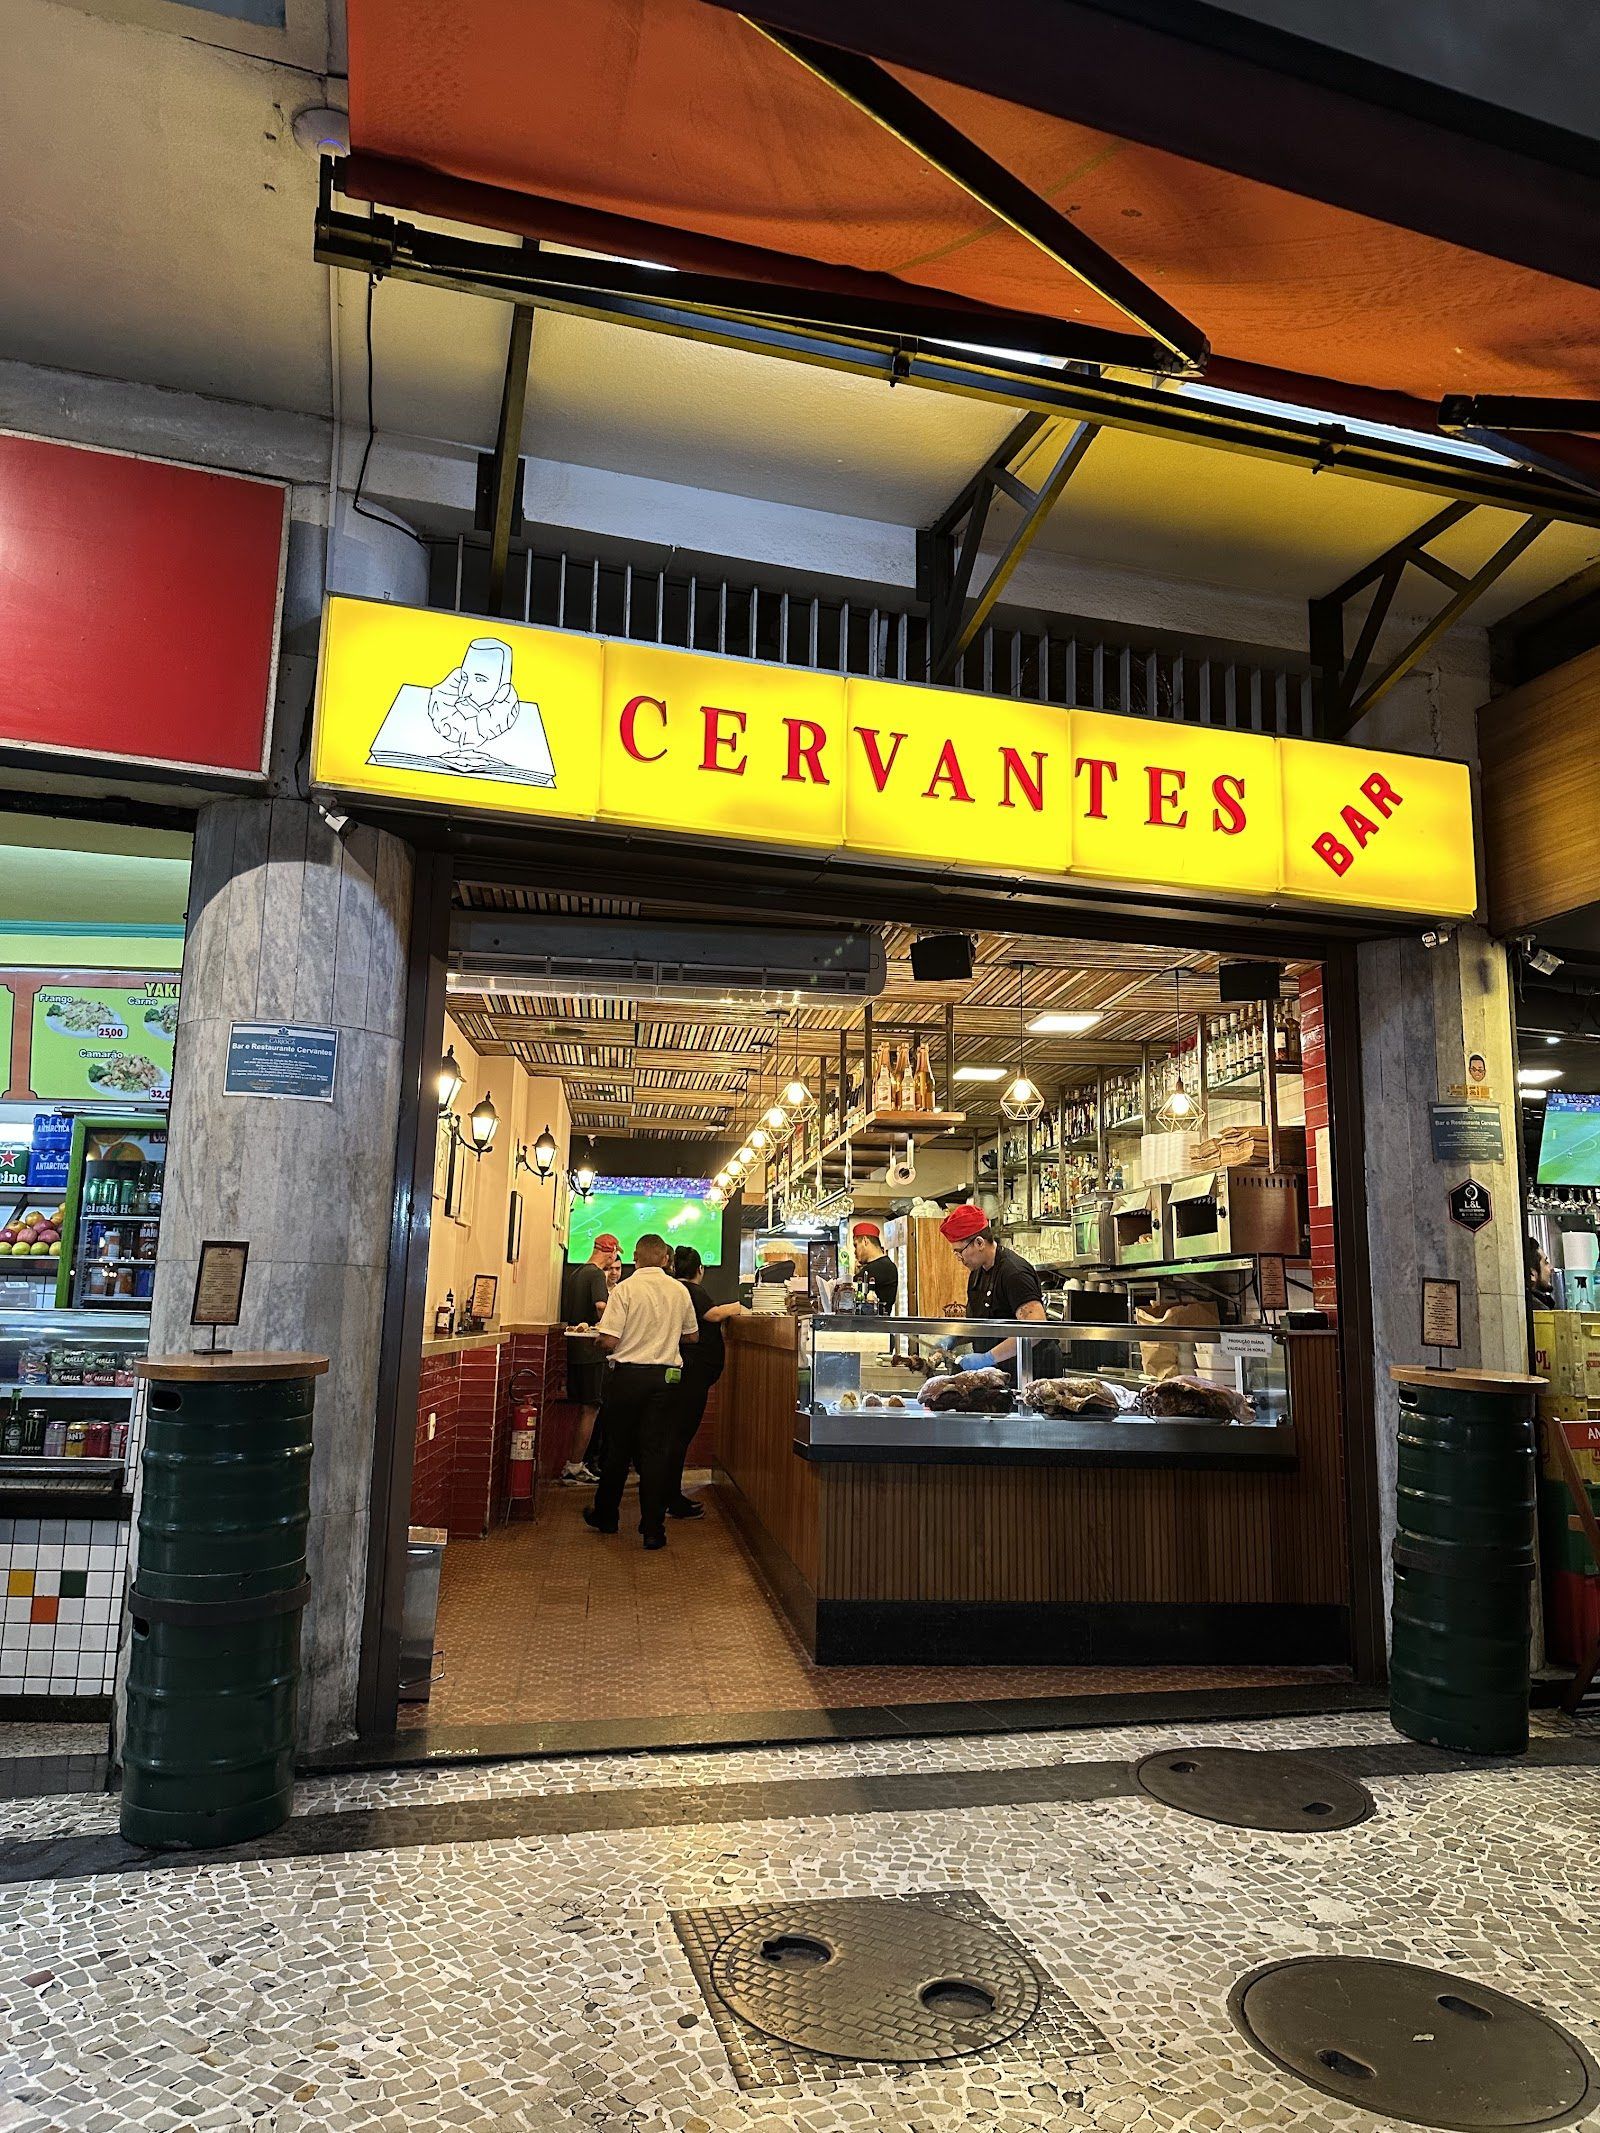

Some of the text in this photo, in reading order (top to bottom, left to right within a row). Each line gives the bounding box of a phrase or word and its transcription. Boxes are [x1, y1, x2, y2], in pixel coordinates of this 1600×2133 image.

[619, 695, 1248, 835] CERVANTES
[1311, 771, 1404, 878] BAR
[39, 994, 73, 1004] Frango
[127, 997, 158, 1006] Carne
[98, 1028, 123, 1039] 25,00
[79, 1049, 124, 1060] Camarão
[232, 1042, 244, 1050] Bar
[251, 1043, 295, 1053] Restaurante
[296, 1047, 333, 1057] Cervantes
[37, 1124, 70, 1133] ANTARCTICA
[35, 1162, 69, 1171] ANTARCTICA
[1464, 1200, 1481, 1209] L&L
